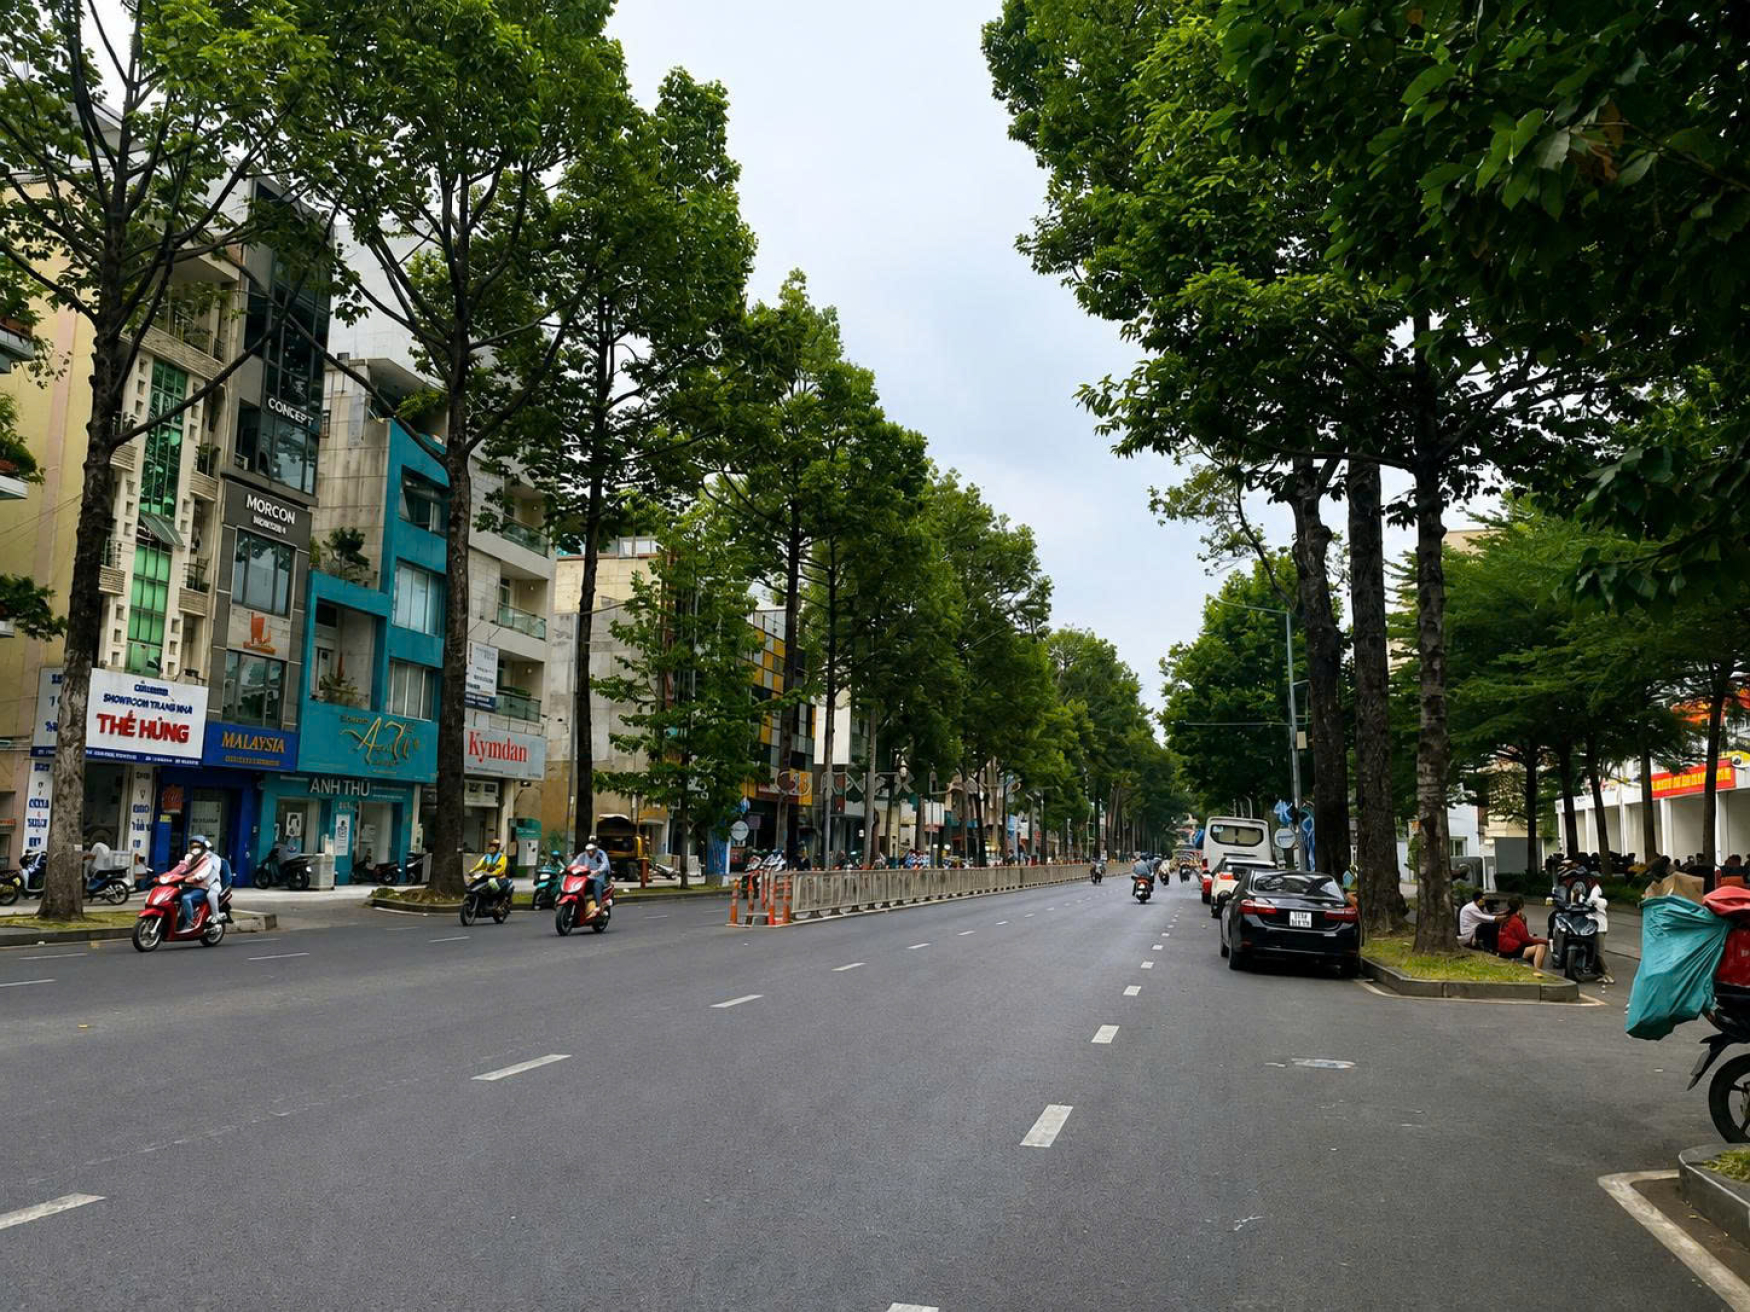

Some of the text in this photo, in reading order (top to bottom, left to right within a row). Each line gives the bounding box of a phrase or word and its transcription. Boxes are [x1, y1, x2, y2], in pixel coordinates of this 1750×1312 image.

[267, 397, 314, 427] CONCEPT
[246, 493, 296, 525] MORCON
[222, 731, 285, 754] MALAYSIA
[468, 731, 527, 763] Kymdan
[310, 777, 341, 795] ANH
